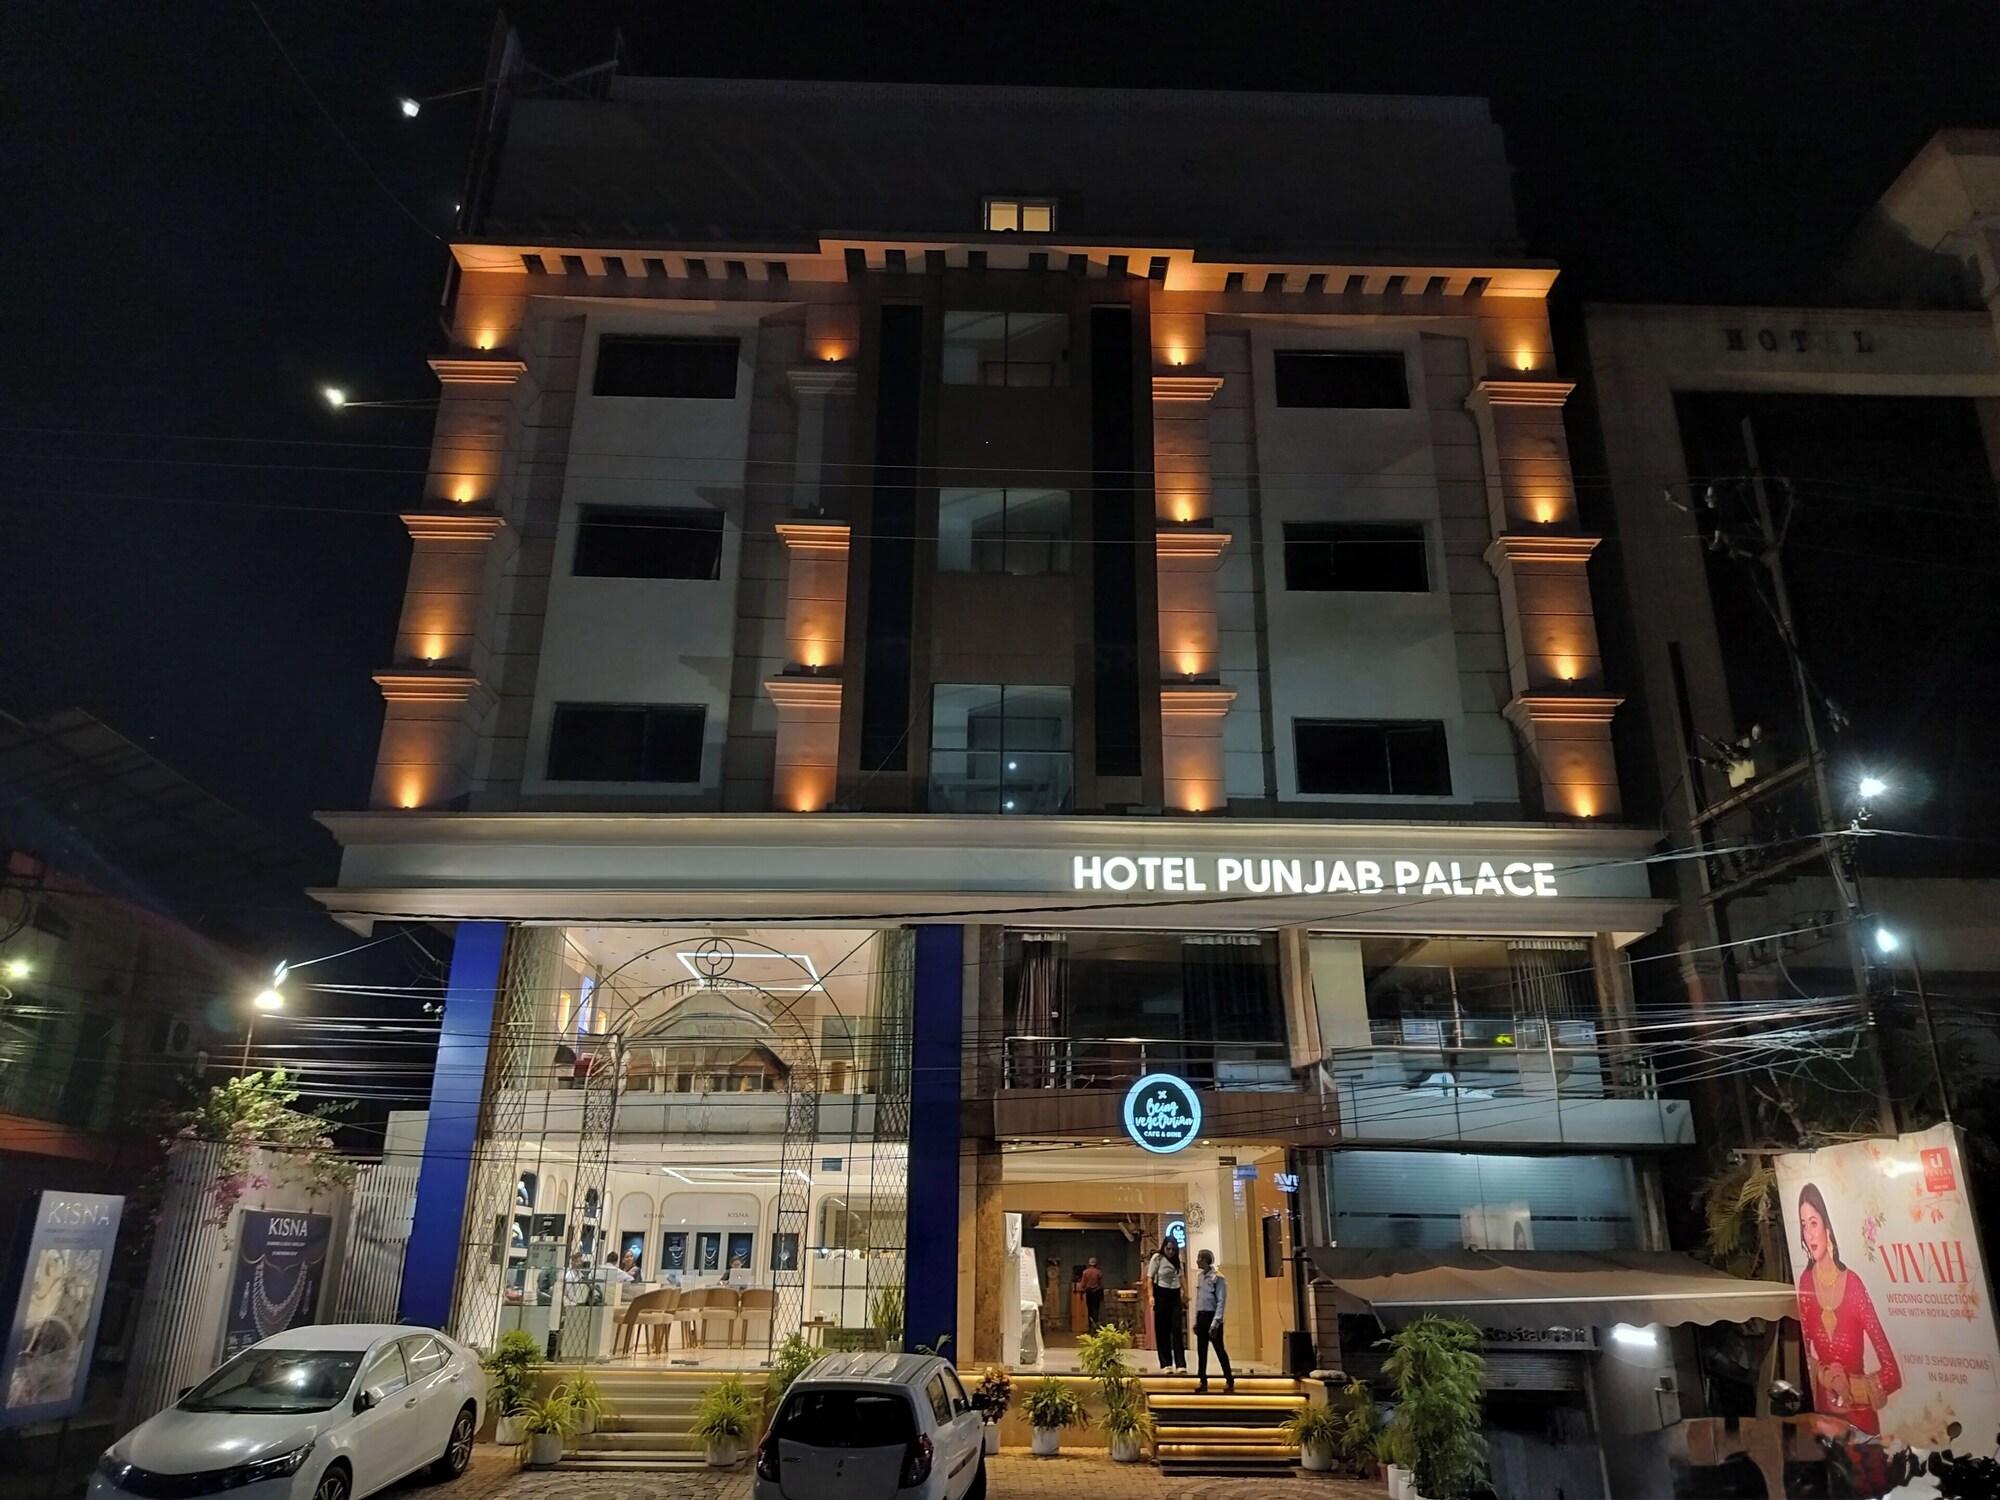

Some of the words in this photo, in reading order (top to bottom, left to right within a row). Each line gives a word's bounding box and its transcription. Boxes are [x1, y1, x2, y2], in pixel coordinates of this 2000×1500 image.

[1073, 856, 1206, 890] HOTEL
[1218, 858, 1384, 895] PUNJAB
[1394, 861, 1558, 896] PALACE
[1135, 1112, 1193, 1130] vegetarian
[47, 1201, 110, 1226] KISNA
[267, 1217, 308, 1237] KISNA
[1878, 1241, 1969, 1283] VIVAH
[1887, 1293, 1922, 1304] WEDDING
[1924, 1294, 1977, 1305] COLLECTION
[1887, 1307, 1907, 1317] SHINE
[1908, 1307, 1926, 1317] WITH
[1927, 1308, 1949, 1318] ROYAL
[1903, 1354, 1923, 1365] NOW
[1924, 1354, 1930, 1366] 3
[1931, 1355, 1990, 1371] SHOWROOMS
[1928, 1371, 1937, 1382] IN
[1938, 1371, 1968, 1385] RAIPUR
